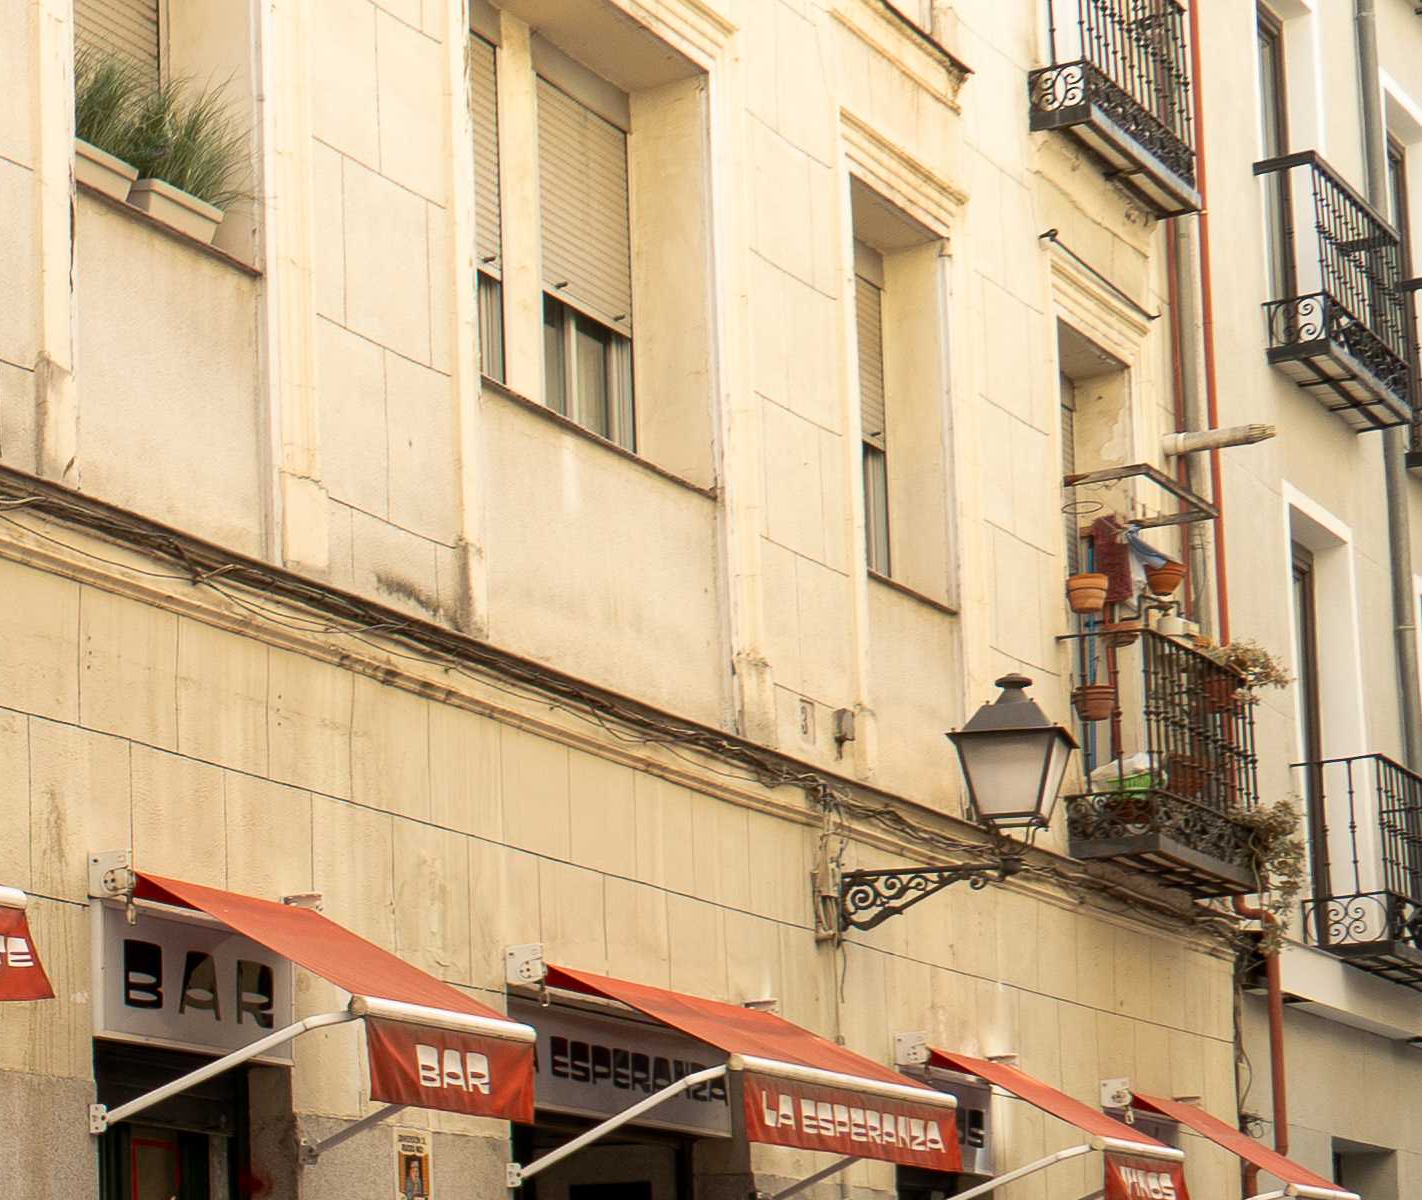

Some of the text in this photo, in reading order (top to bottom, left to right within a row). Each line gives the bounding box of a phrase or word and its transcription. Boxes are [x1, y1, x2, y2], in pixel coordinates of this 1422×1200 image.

[124, 939, 274, 1029] BAR
[416, 1044, 491, 1095] BAR
[550, 1036, 729, 1106] ESPERANZA
[762, 1090, 796, 1130] LA
[800, 1098, 946, 1154] ESPERANZA
